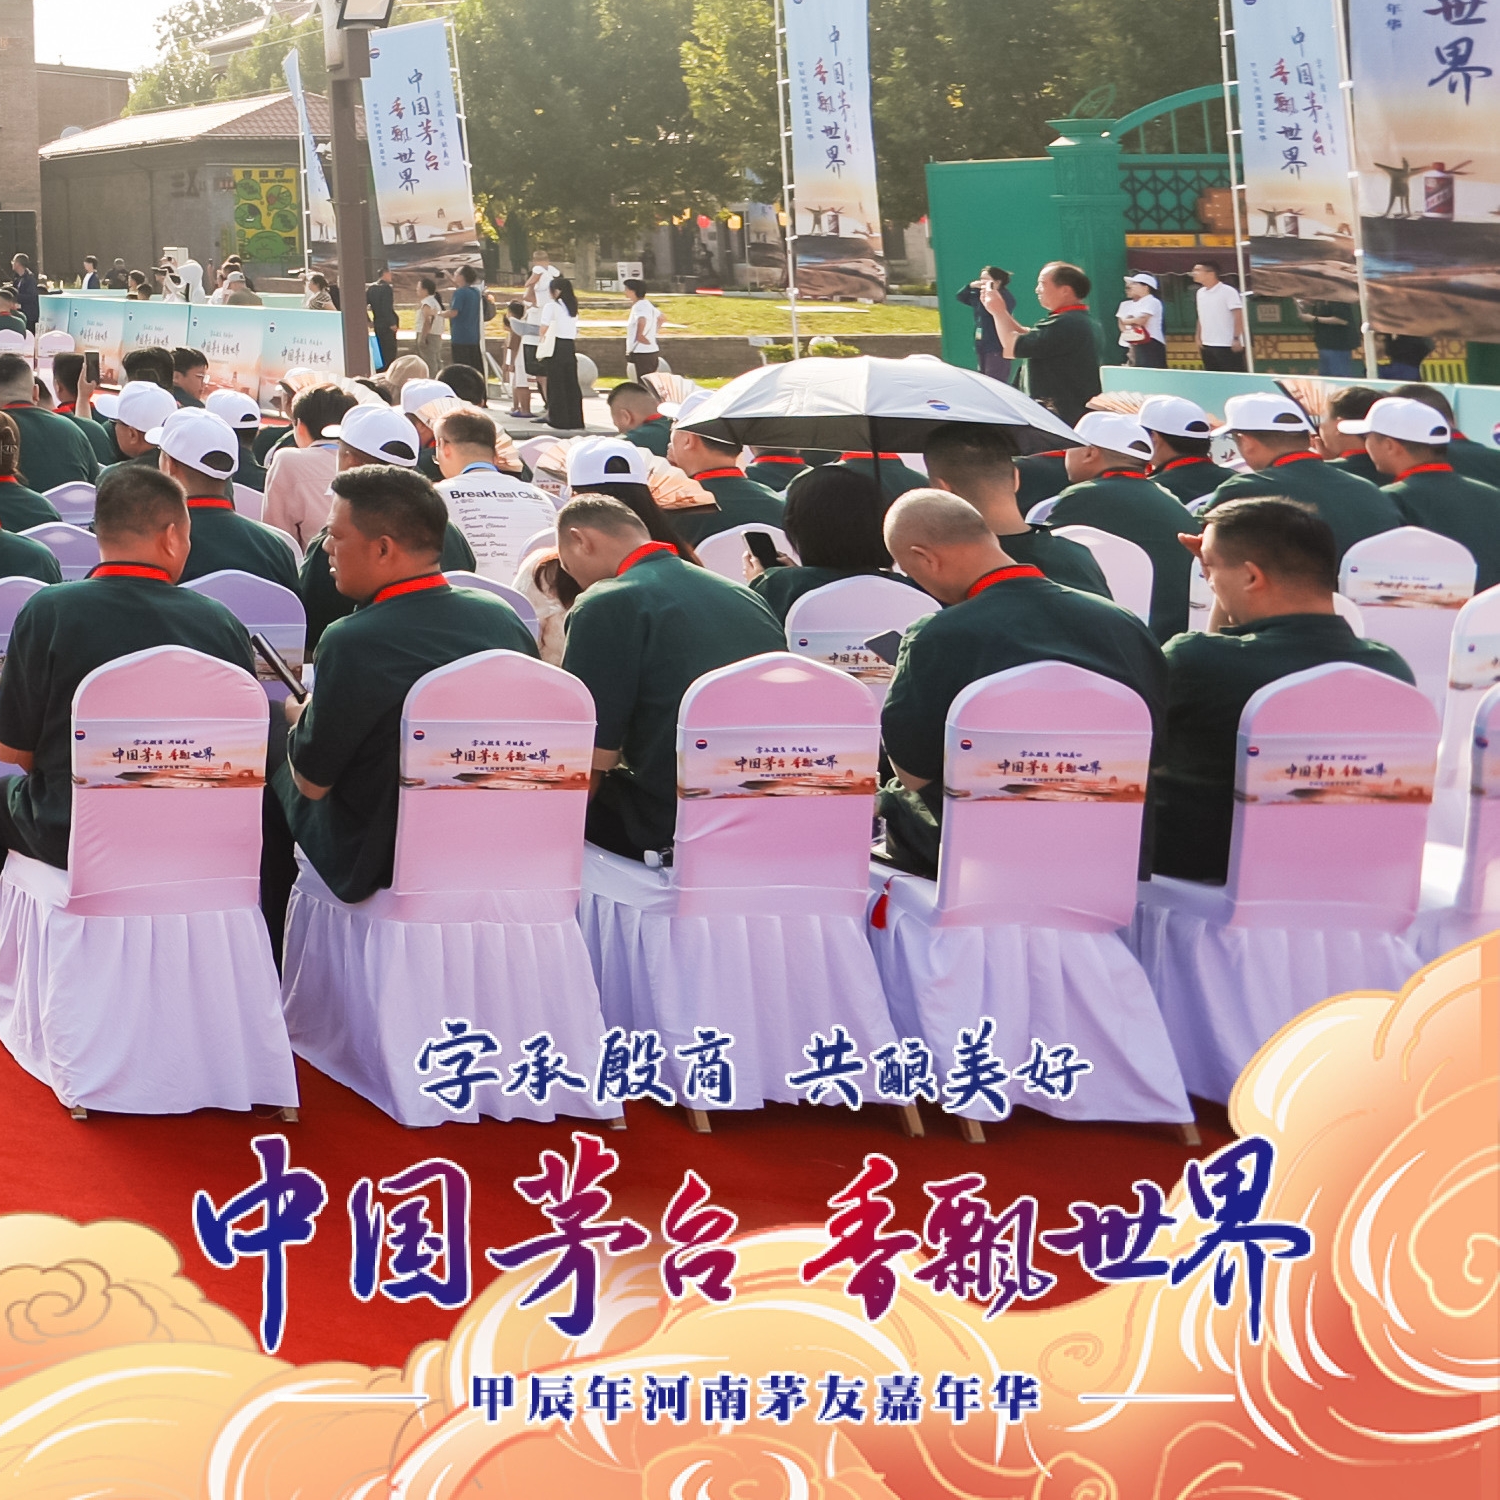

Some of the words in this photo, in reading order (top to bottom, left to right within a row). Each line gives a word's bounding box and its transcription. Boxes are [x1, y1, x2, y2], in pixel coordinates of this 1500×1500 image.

[1291, 26, 1326, 156] 中国茅台
[407, 68, 440, 172] 中国茅台
[813, 56, 846, 180] 香飘世界
[1269, 57, 1308, 180] 香飘世界
[388, 96, 420, 195] 香飘世界
[450, 490, 518, 499] Breakfast
[111, 747, 163, 765] 中国茅台
[450, 747, 500, 765] 中国茅台
[734, 755, 785, 772] 中国茅台
[997, 759, 1049, 775] 中国茅台
[1284, 762, 1335, 780] 中国茅台
